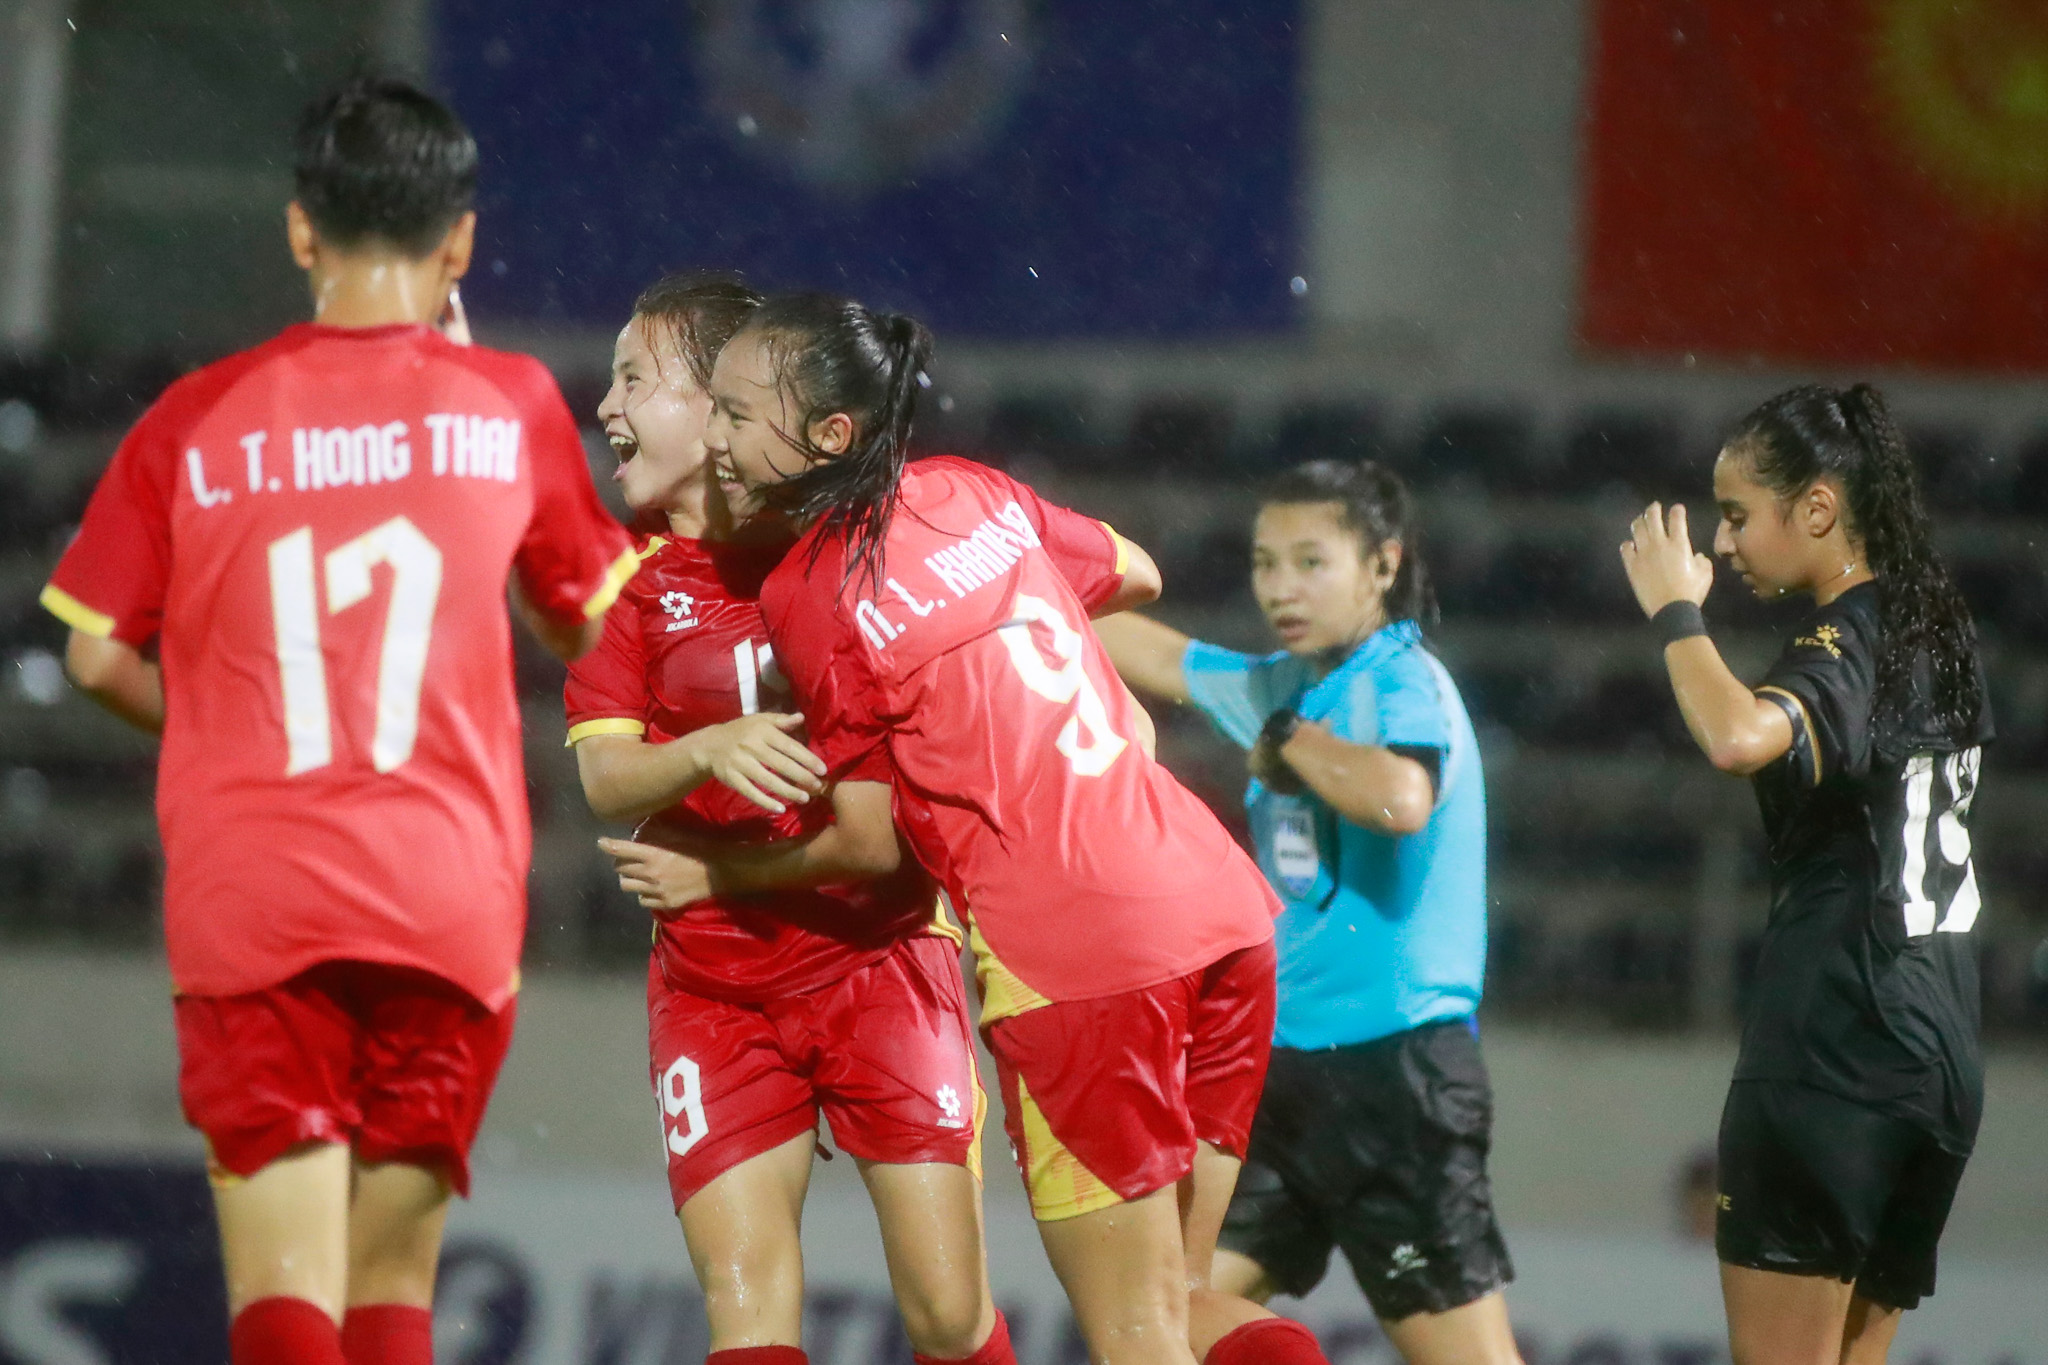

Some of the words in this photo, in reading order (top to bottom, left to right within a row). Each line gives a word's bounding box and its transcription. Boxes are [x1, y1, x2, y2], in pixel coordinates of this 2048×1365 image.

[186, 447, 232, 508] L.
[239, 430, 281, 493] T.
[292, 419, 411, 490] HONG
[424, 413, 521, 482] THAI
[267, 515, 443, 777] 17
[998, 592, 1129, 776] 9
[1901, 746, 1982, 937] 19
